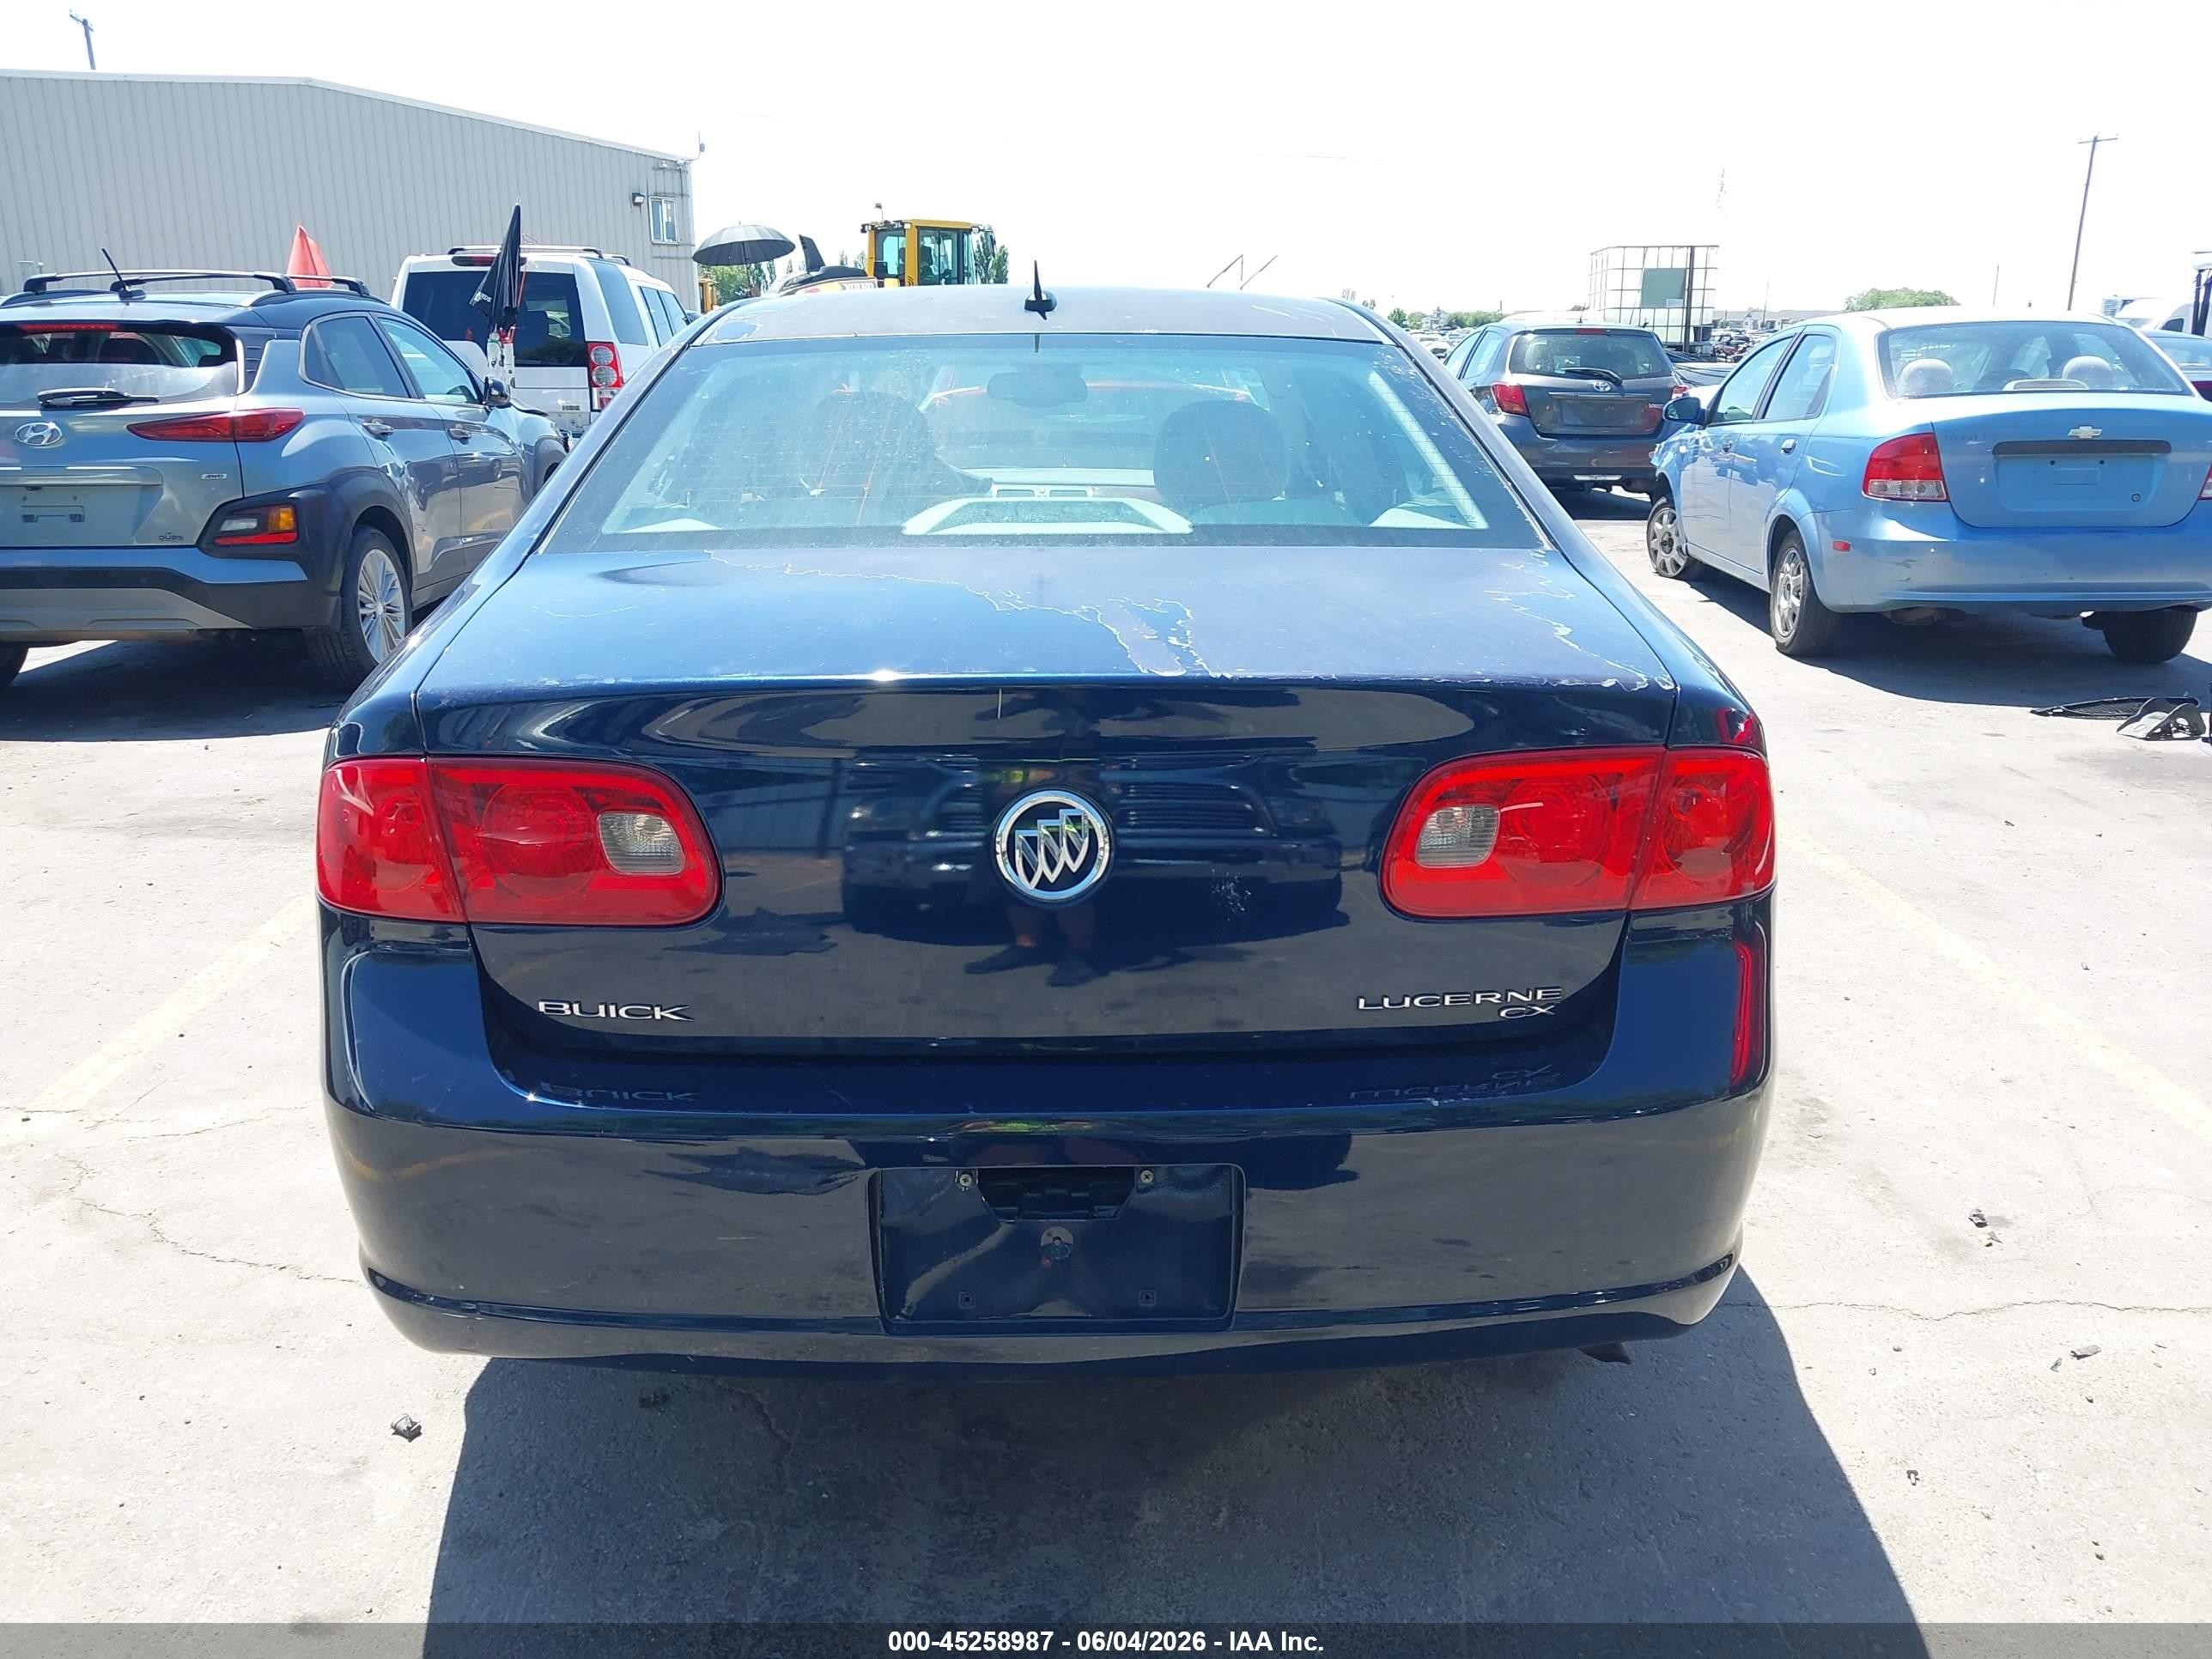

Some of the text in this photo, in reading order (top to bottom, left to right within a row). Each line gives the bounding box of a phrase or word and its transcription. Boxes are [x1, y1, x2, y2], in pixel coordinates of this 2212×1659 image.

[1357, 988, 1563, 1010] LUCERNE
[538, 1000, 696, 1023] BUICK
[1499, 1004, 1556, 1020] CX
